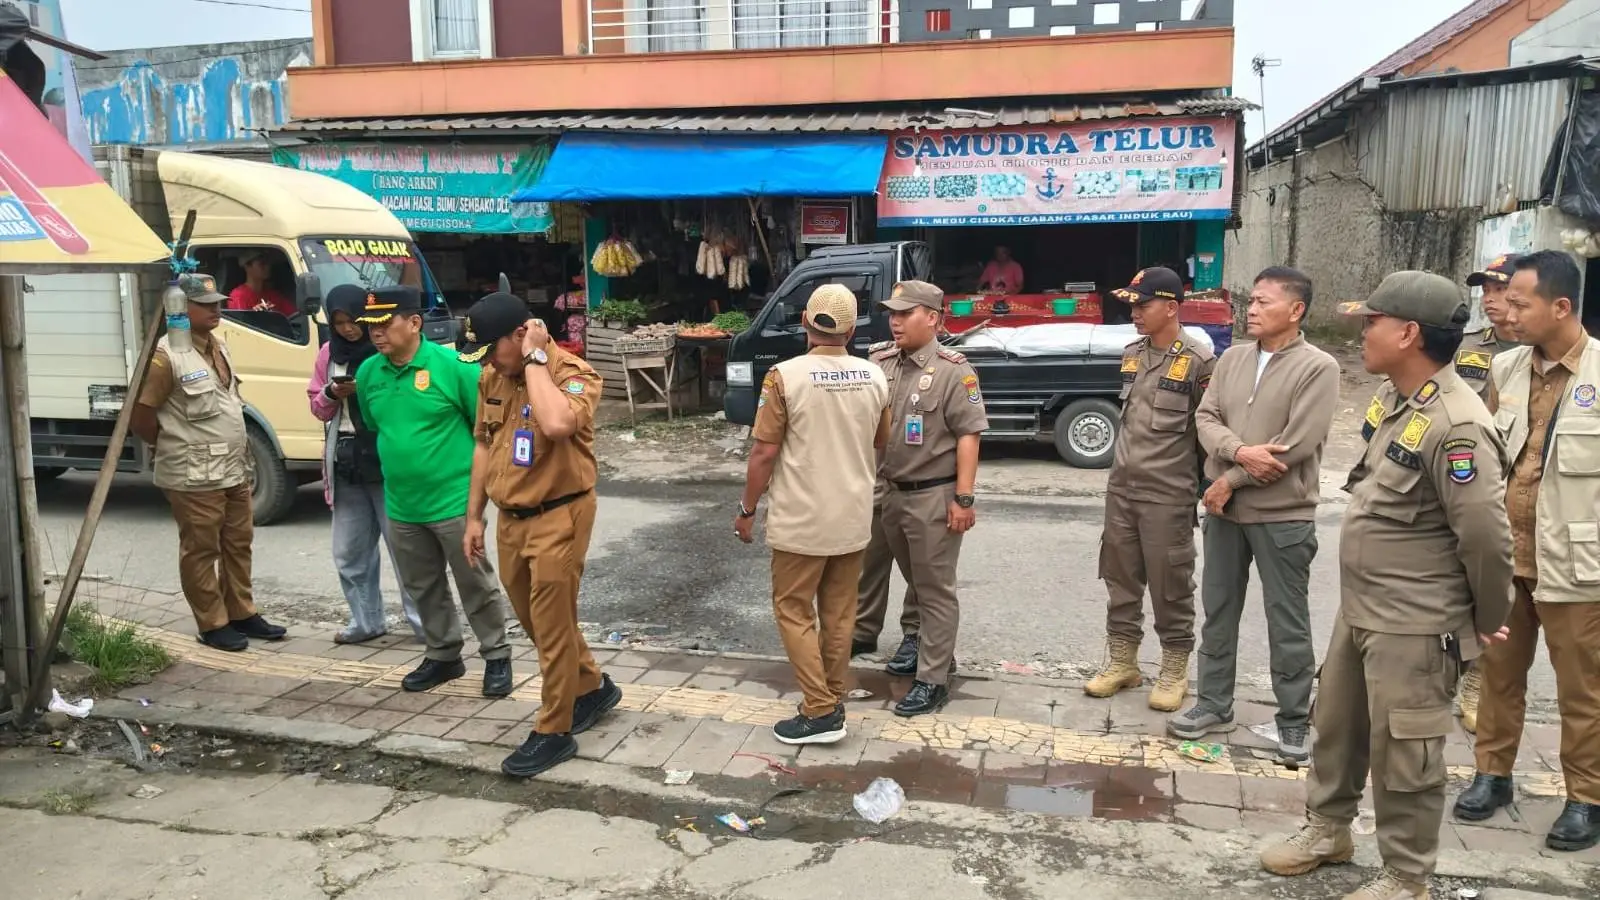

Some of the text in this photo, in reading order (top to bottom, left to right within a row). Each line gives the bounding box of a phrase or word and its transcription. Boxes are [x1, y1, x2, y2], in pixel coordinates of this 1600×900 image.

[894, 124, 1217, 160] SAMUDRA TELUR
[1002, 157, 1070, 168] GROSIR
[1076, 156, 1114, 166] DAN
[1120, 152, 1193, 164] ECERAN
[412, 196, 434, 212] HASIL
[911, 217, 930, 225] JL.
[969, 216, 1014, 225] CISOKA
[1075, 213, 1116, 222] PASAR
[1119, 211, 1160, 221] INDUK
[1162, 211, 1193, 220] RAU)
[324, 239, 411, 258] BOJO GALAK
